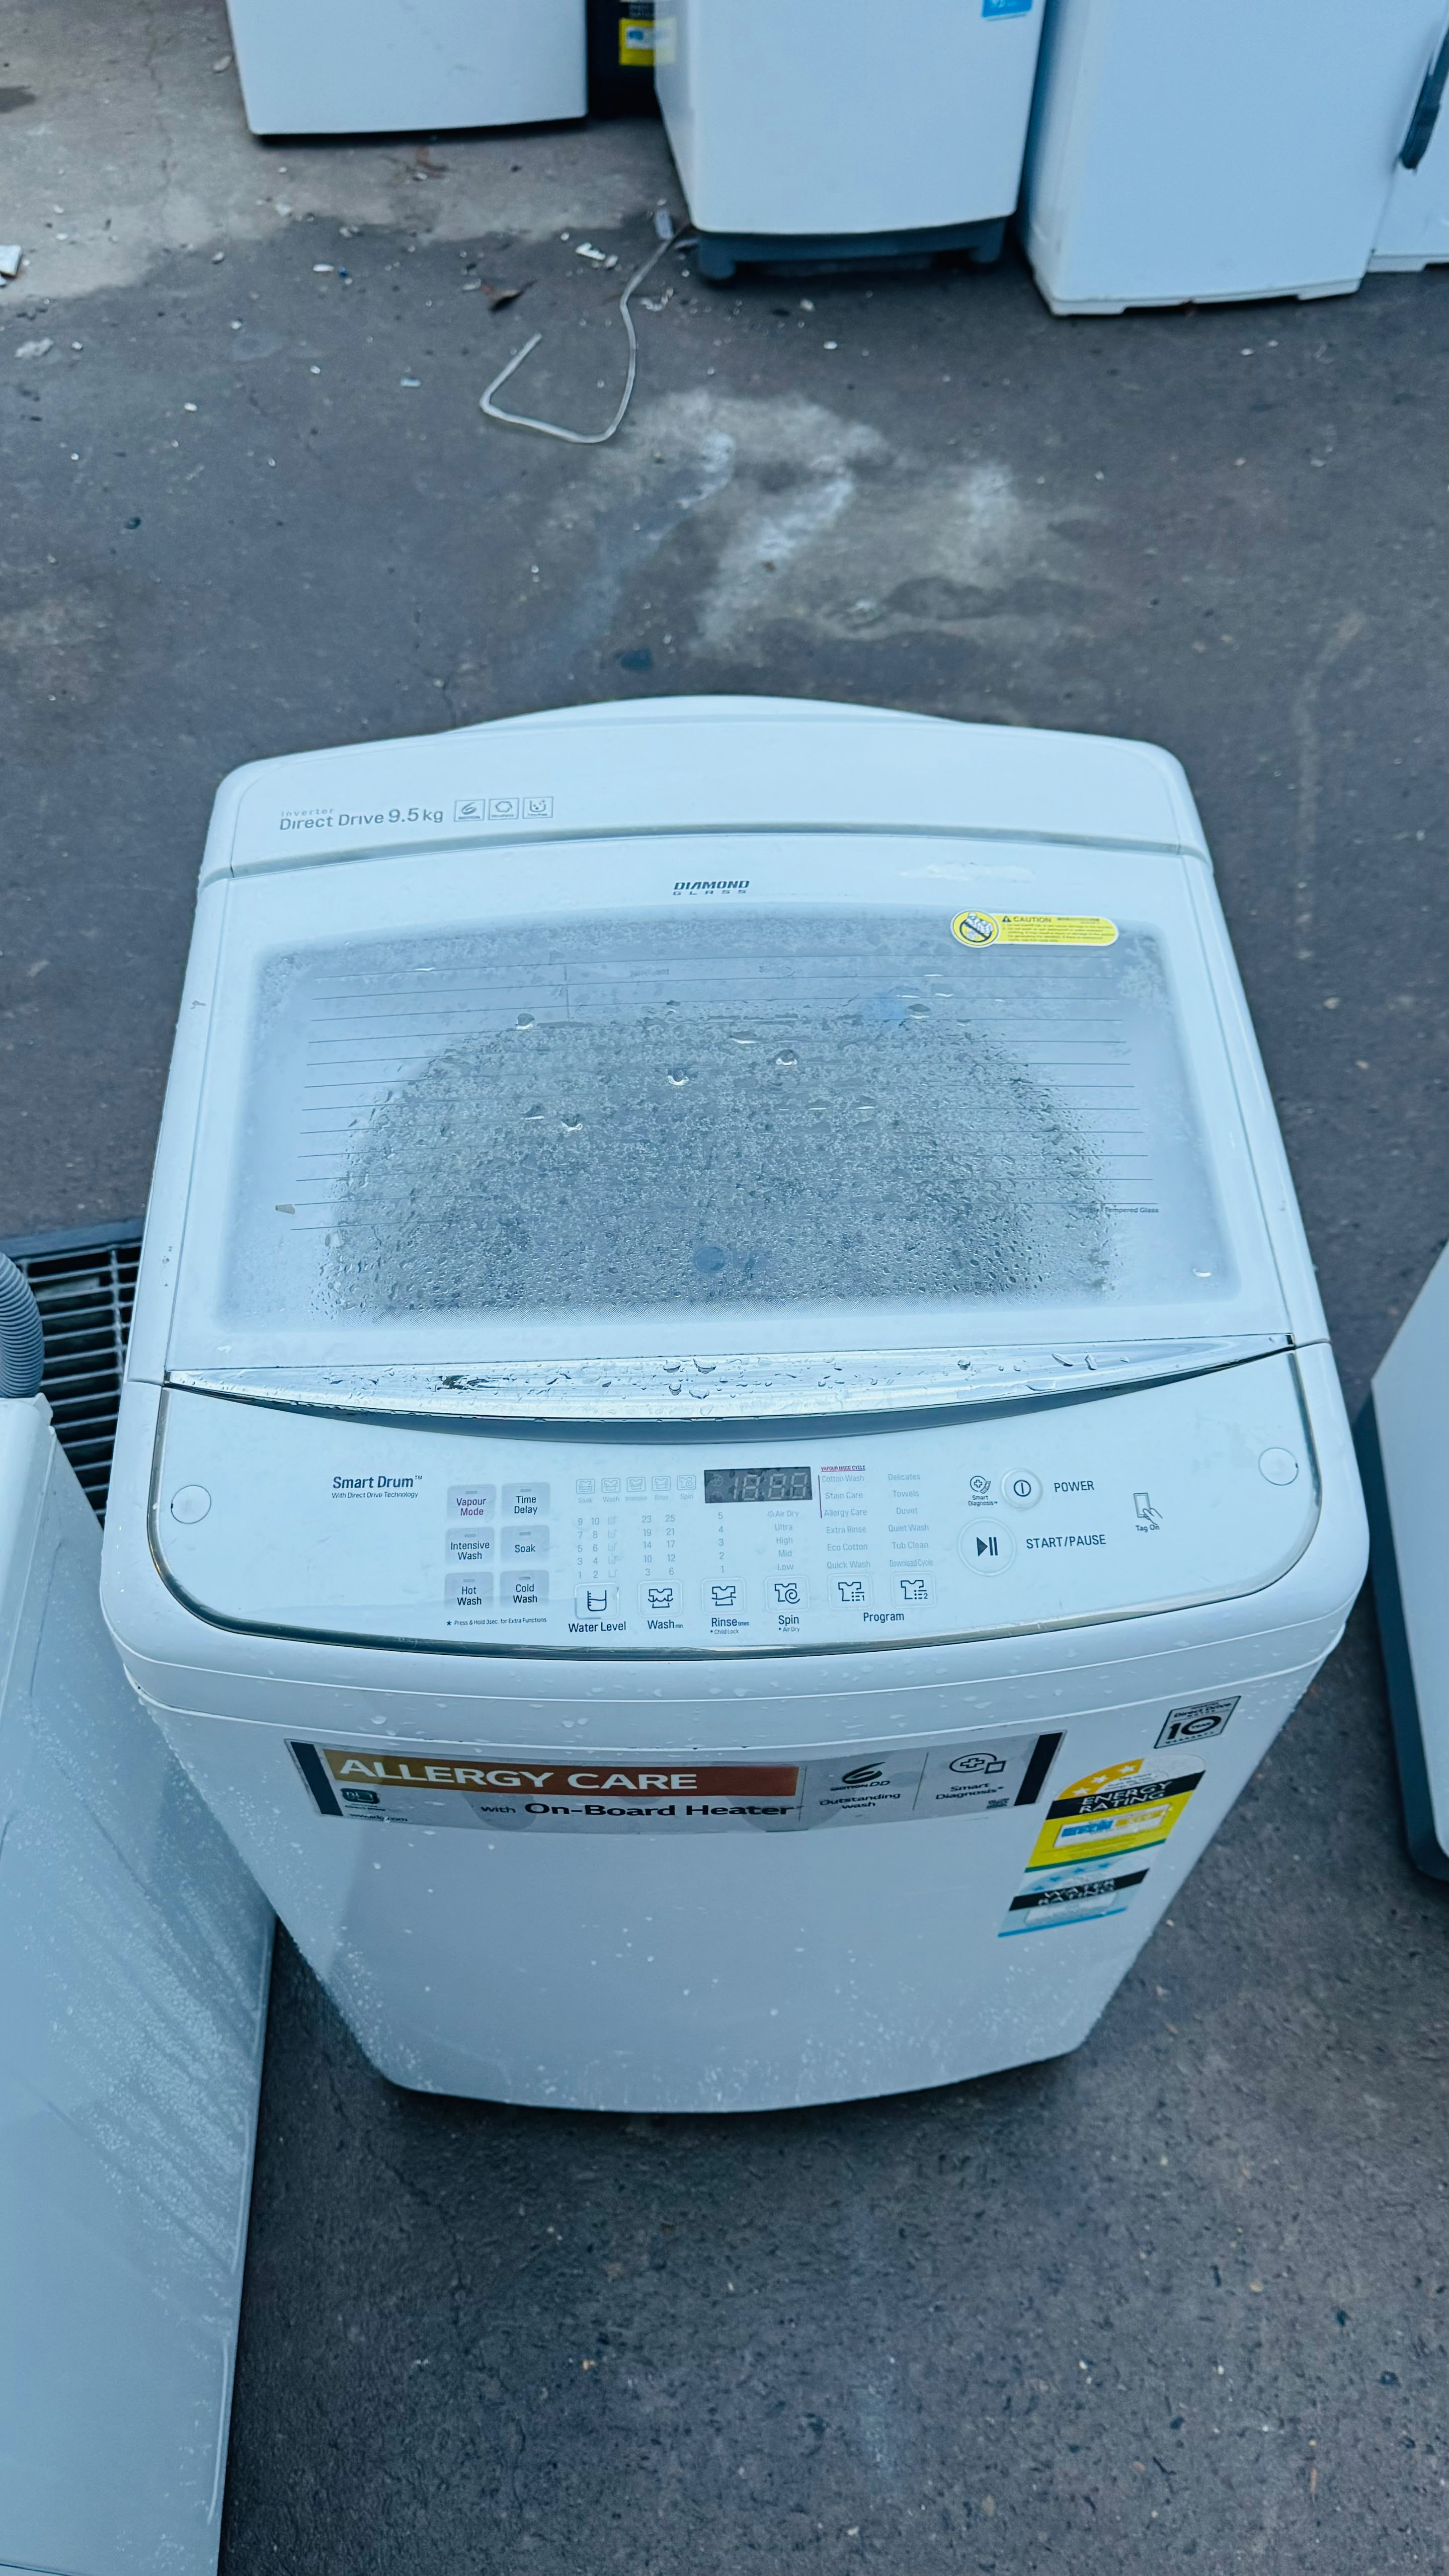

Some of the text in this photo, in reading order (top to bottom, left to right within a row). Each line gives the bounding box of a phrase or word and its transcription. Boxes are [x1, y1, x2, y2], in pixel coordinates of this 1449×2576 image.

[280, 808, 443, 830] Direct Drive 9.5 kg
[673, 880, 750, 890] DIAMOND
[333, 1476, 374, 1489] Smart
[1054, 1480, 1095, 1492] POWER
[456, 1497, 487, 1507] Vapour
[516, 1495, 536, 1503] Time
[460, 1507, 484, 1516] Mode
[514, 1506, 538, 1515] Delay
[787, 1510, 799, 1518] Dry
[824, 1509, 849, 1517] Allergy
[591, 1517, 599, 1525] 10
[641, 1515, 652, 1523] 23
[665, 1514, 675, 1522] 25
[643, 1528, 652, 1537] 19
[666, 1527, 675, 1536] 21
[888, 1524, 907, 1533] Quiet
[592, 1531, 598, 1539] 8
[450, 1541, 490, 1550] Intensive
[643, 1541, 652, 1549] 14
[666, 1540, 675, 1548] 17
[776, 1537, 793, 1545] High
[1026, 1534, 1106, 1549] START/PAUSE
[515, 1544, 536, 1553] Soak
[843, 1543, 868, 1551] Cotton
[458, 1551, 482, 1560] Wash
[643, 1555, 652, 1563] 10
[719, 1552, 725, 1560] 2
[777, 1563, 794, 1571] Low
[827, 1560, 871, 1569] Quick Wash
[890, 1559, 933, 1567] Download Cycle
[645, 1568, 651, 1576] 3
[669, 1567, 674, 1575] 6
[720, 1565, 724, 1573] 1
[579, 1571, 582, 1579] 1
[593, 1570, 598, 1578] 2
[461, 1586, 477, 1594] Hot
[516, 1584, 534, 1592] Cold
[457, 1597, 481, 1605] Wash
[513, 1595, 537, 1603] Wash
[711, 1618, 737, 1627] Rinse
[778, 1615, 799, 1626] Spin
[863, 1612, 904, 1624] Program
[569, 1621, 626, 1633] Water Level
[648, 1620, 675, 1629] Wash
[1167, 1715, 1222, 1740] 10
[340, 1759, 697, 1790] ALLERGY CARE
[950, 1783, 991, 1792] Smart
[1082, 1781, 1173, 1805] ENERGY
[820, 1793, 901, 1806] Outstanding
[1079, 1790, 1165, 1814] RATING
[525, 1803, 676, 1816] On-Board
[842, 1801, 876, 1809] wash
[349, 1813, 408, 1822] www.lgcom
